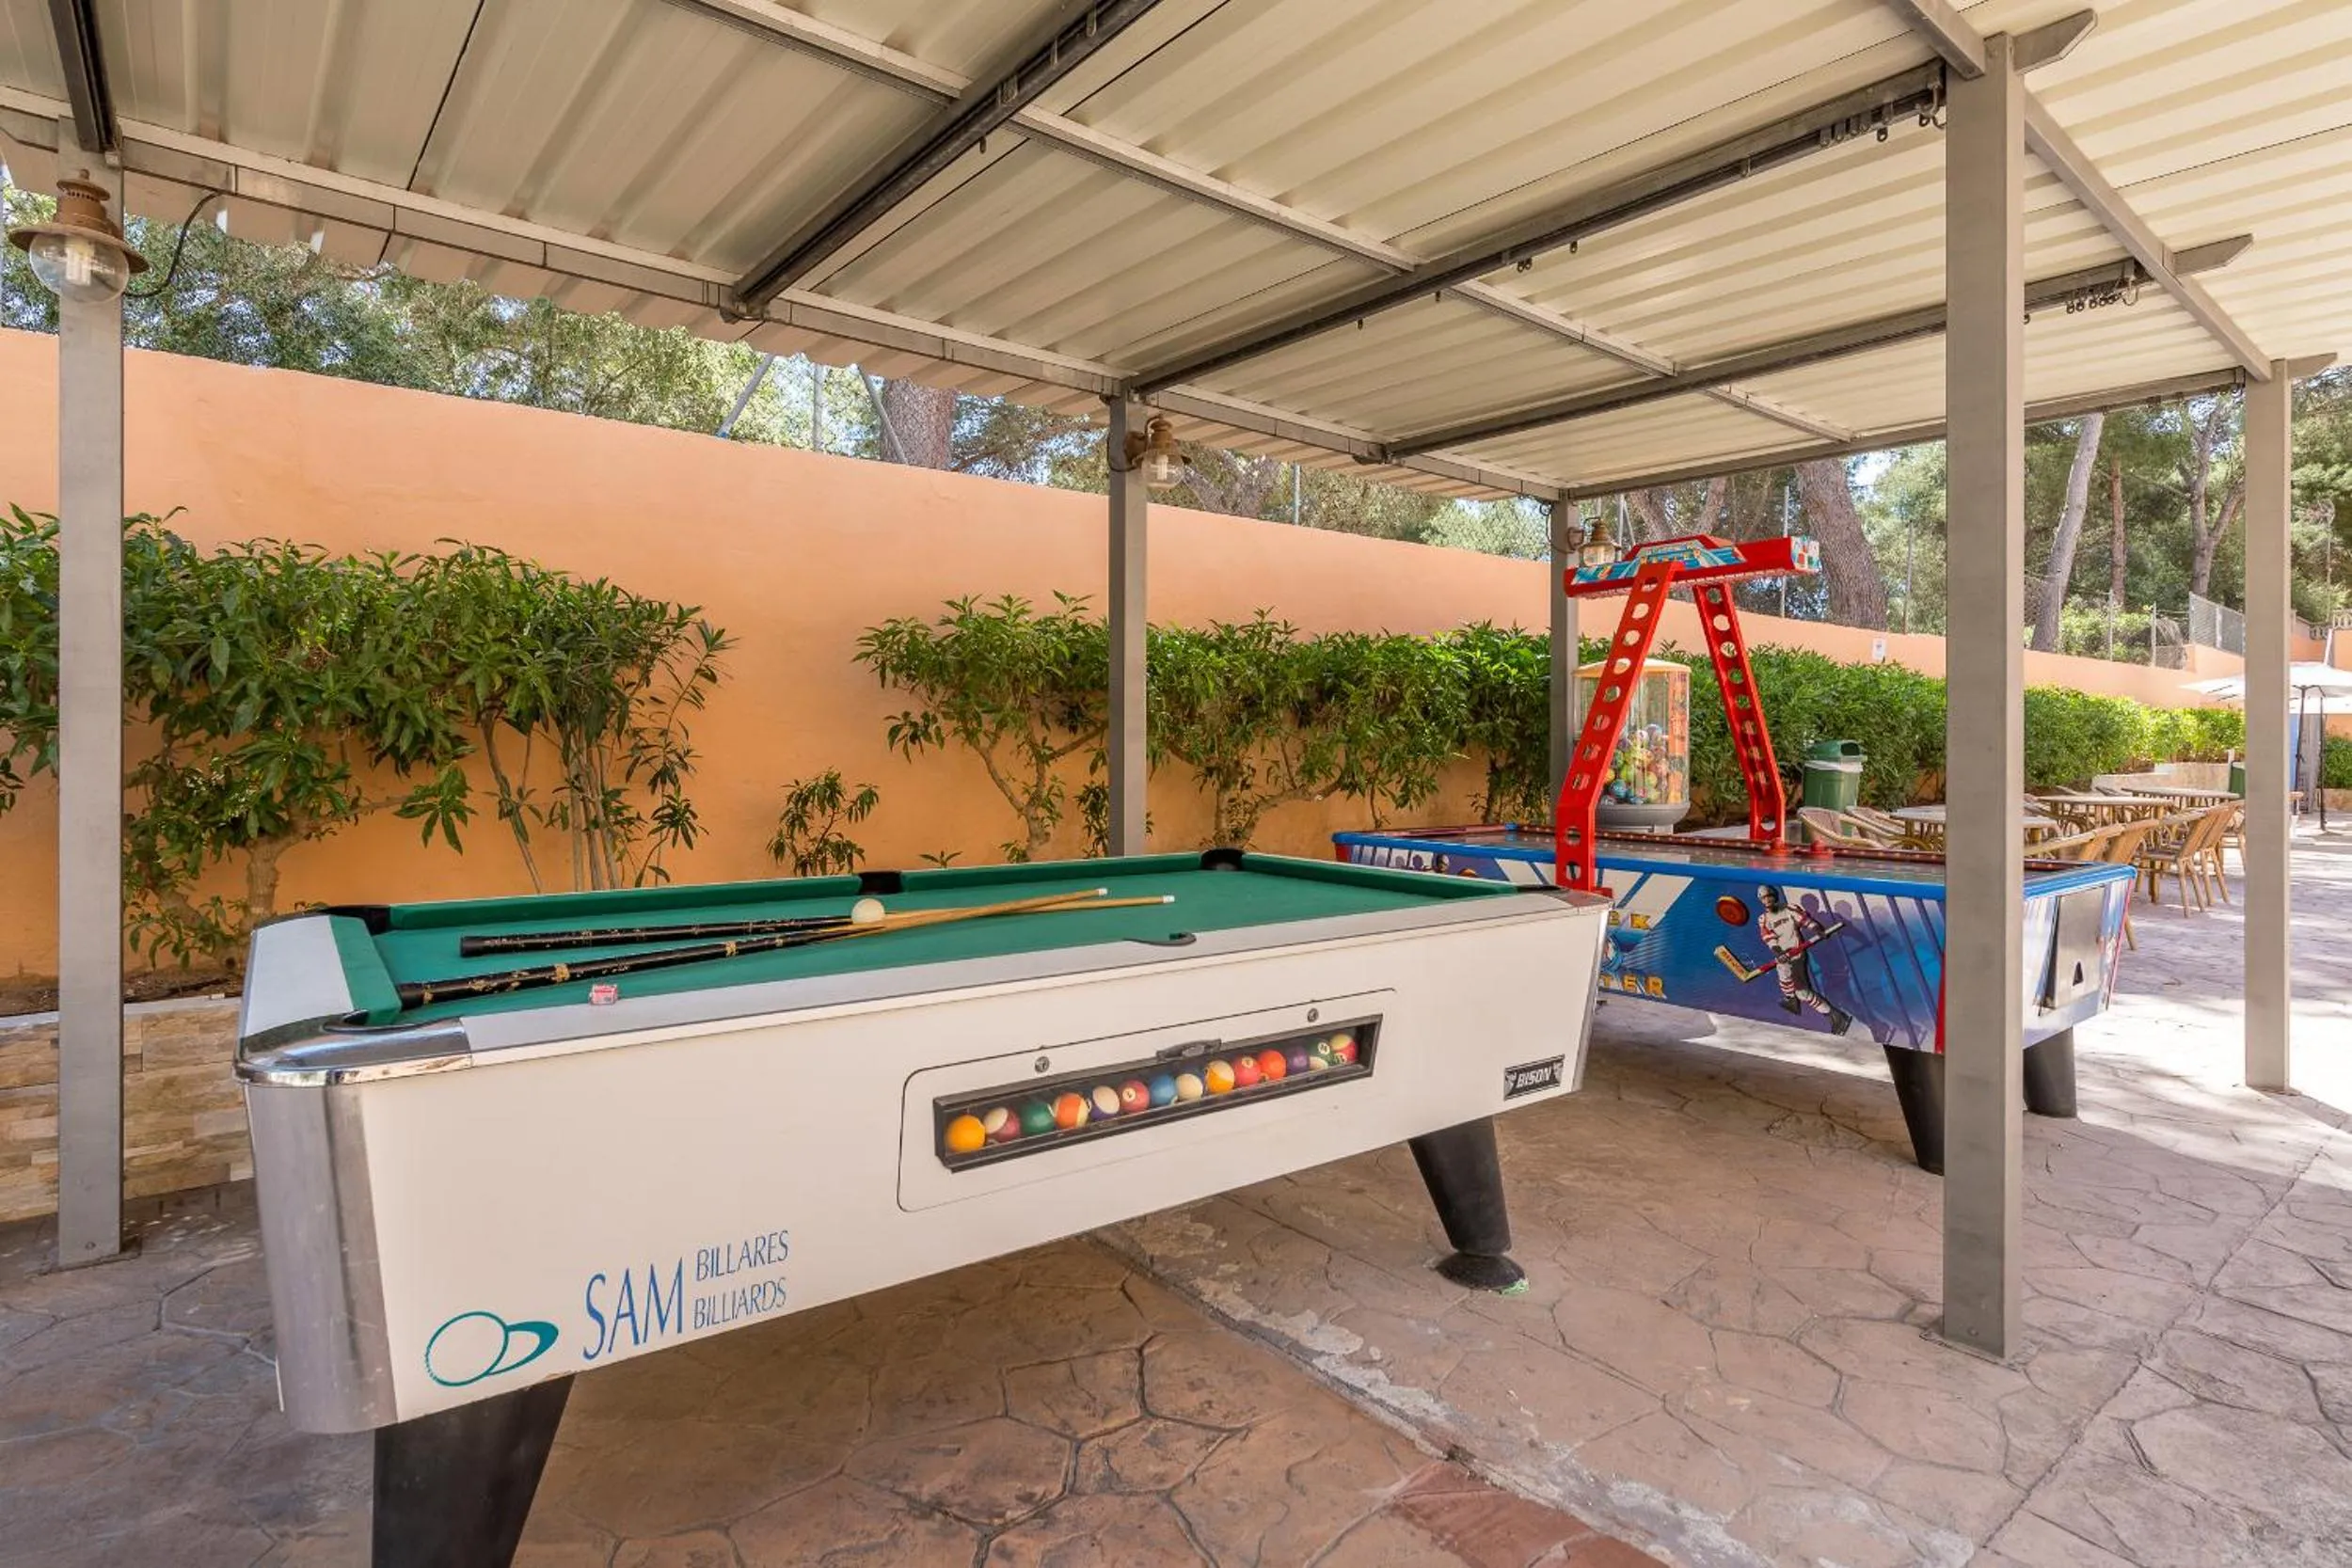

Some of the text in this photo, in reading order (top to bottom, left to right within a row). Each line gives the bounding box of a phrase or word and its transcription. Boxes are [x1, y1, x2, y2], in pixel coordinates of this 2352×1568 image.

[1517, 1067, 1552, 1088] BISON
[696, 1229, 789, 1281] BILLARES
[582, 1257, 683, 1360] SAM
[693, 1276, 787, 1329] BILLIARDS
